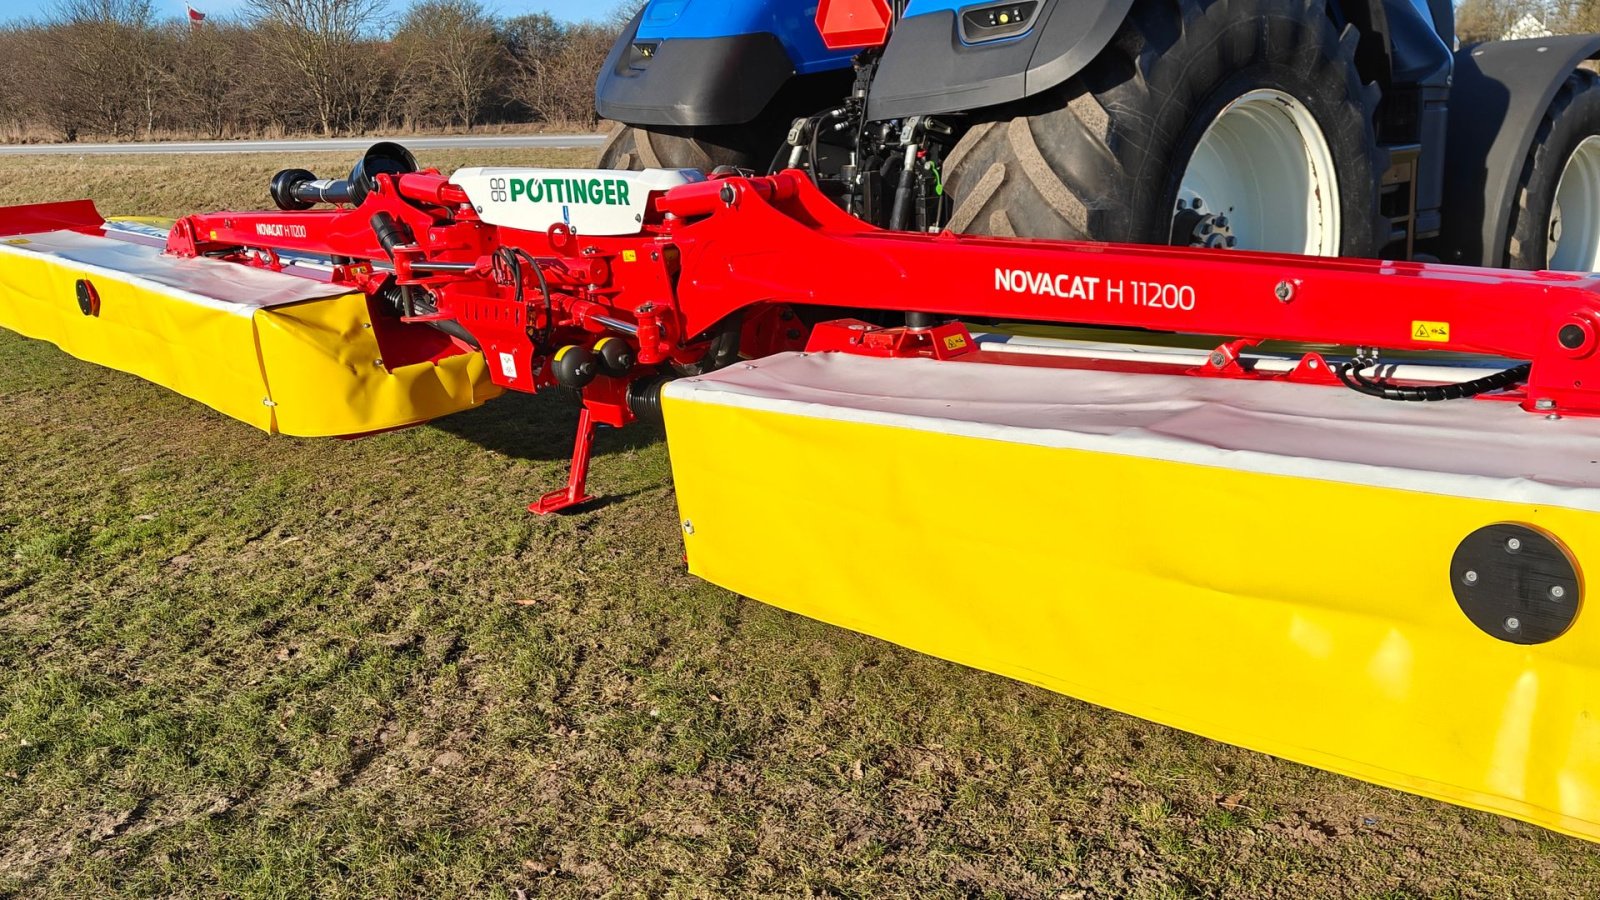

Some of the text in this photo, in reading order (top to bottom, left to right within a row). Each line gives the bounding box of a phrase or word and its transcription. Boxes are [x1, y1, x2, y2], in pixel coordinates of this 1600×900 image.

[509, 178, 630, 206] PÖTTINGER
[255, 223, 306, 238] NOVACAT H 11200
[994, 268, 1196, 311] NOVACAT H 11200
